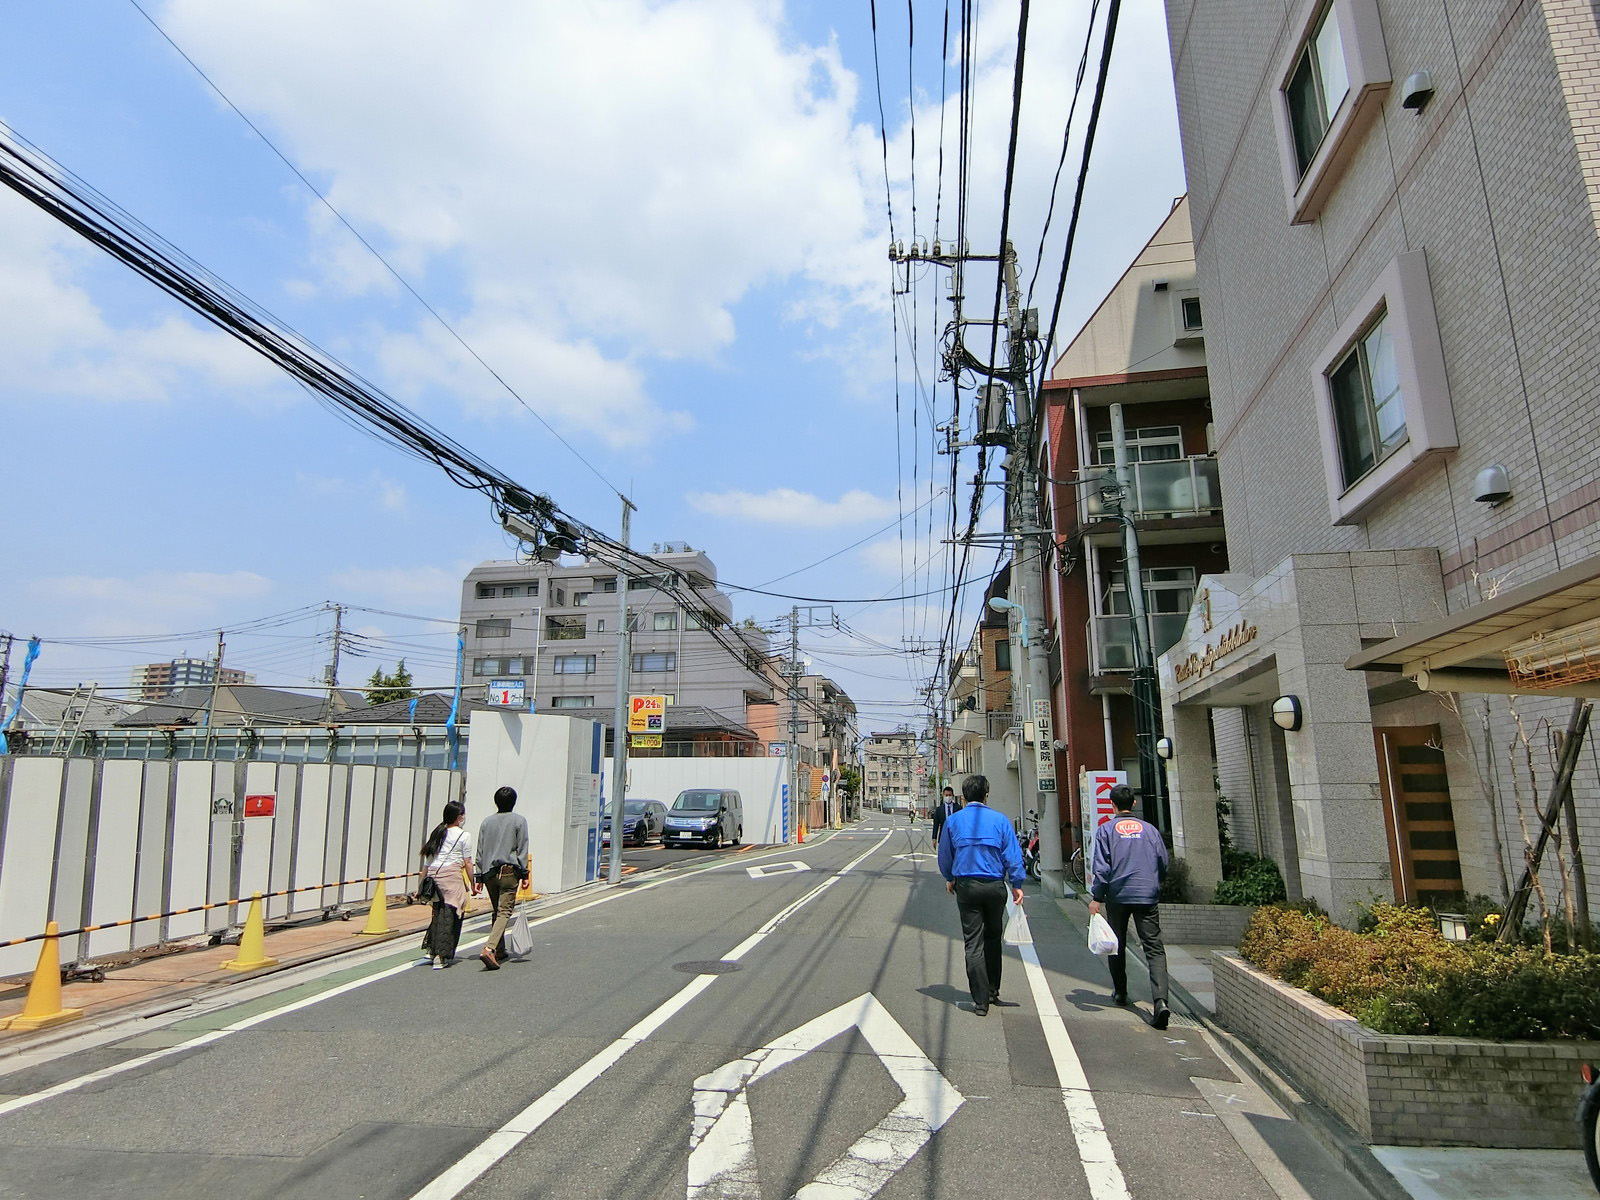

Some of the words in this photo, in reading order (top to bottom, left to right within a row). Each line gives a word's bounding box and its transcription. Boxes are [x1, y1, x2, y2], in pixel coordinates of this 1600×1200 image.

[501, 689, 509, 704] 1
[633, 698, 645, 713] P
[645, 699, 661, 709] 24h
[1038, 719, 1051, 761] 山下医院
[1119, 823, 1139, 831] KUZE
